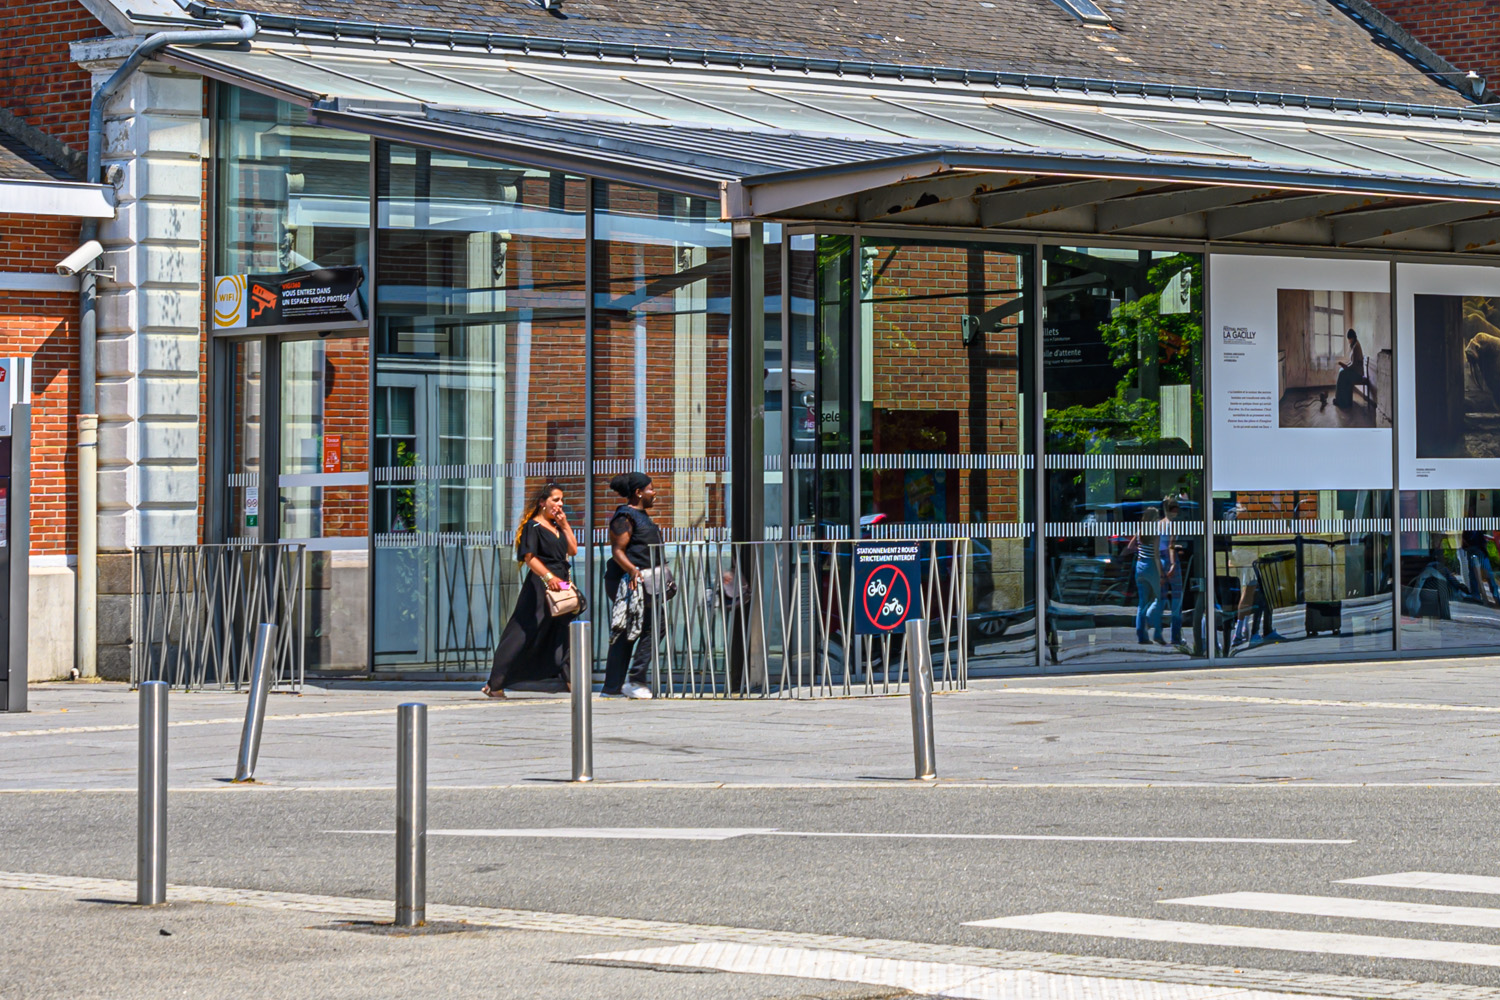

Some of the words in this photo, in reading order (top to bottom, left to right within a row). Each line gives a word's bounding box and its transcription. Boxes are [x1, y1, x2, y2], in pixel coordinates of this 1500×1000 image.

[297, 288, 316, 296] ENTREZ
[316, 287, 331, 295] DANS
[219, 293, 235, 302] WIFI
[291, 297, 310, 305] ESPACE
[310, 295, 326, 304] VIDÉO
[1223, 331, 1231, 339] LA
[1232, 331, 1256, 339] GACILLY
